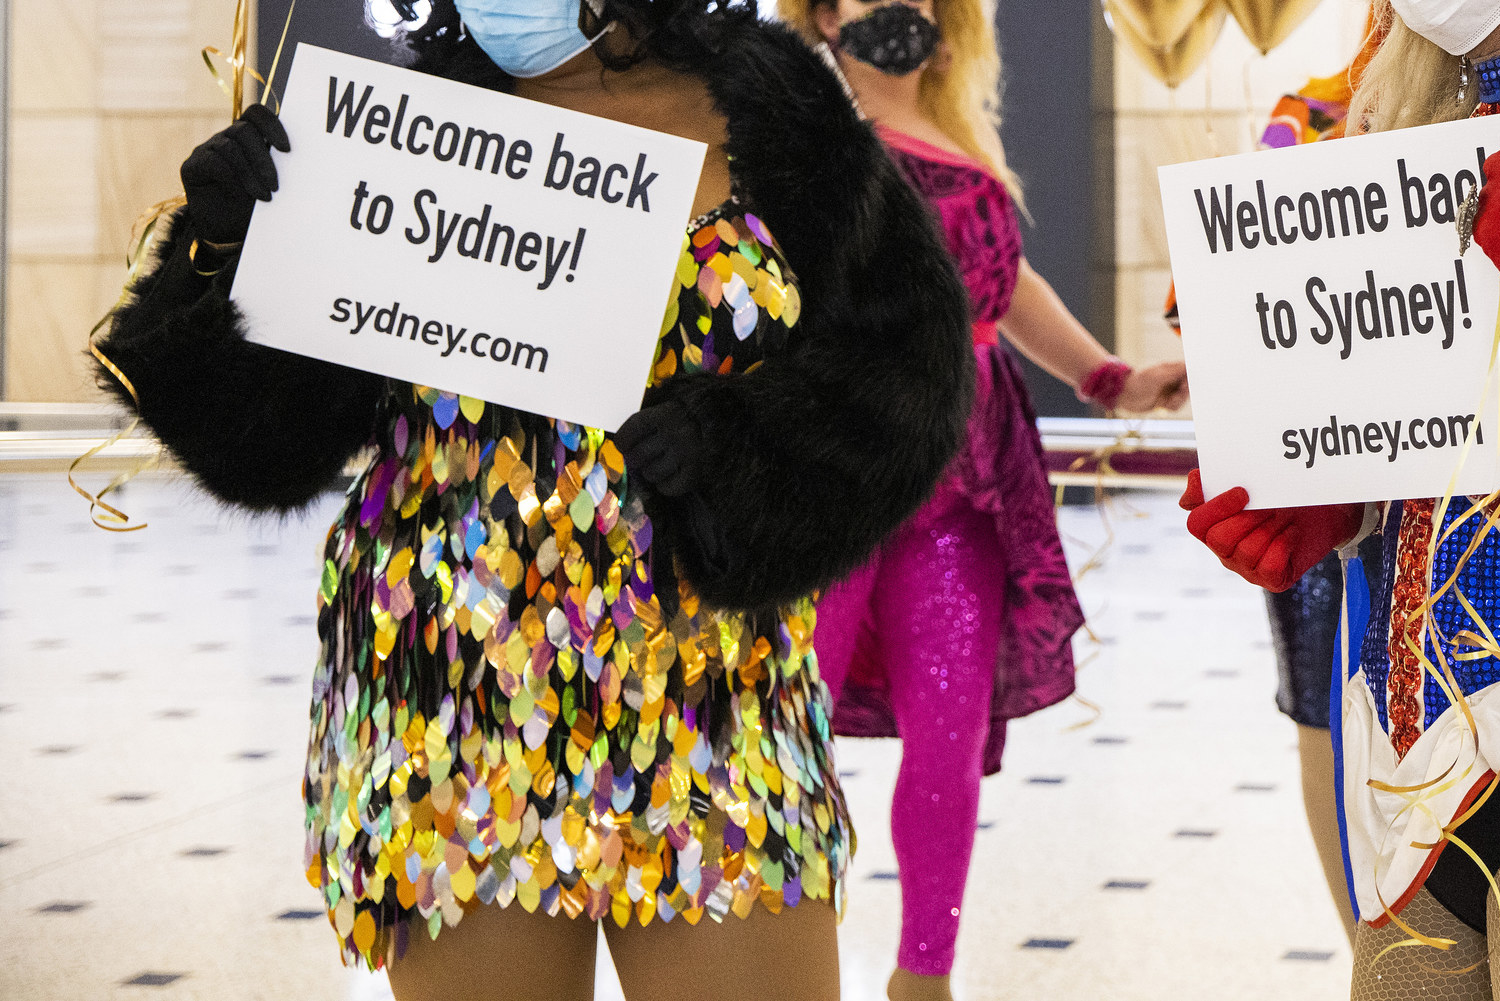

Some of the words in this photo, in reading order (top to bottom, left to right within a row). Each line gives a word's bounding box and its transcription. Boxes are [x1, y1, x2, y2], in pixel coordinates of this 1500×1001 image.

[326, 76, 532, 179] Welcome
[544, 133, 659, 212] back
[350, 180, 394, 234] to
[405, 188, 586, 290] Sydney!
[1194, 180, 1389, 253] Welcome
[329, 297, 549, 372] sydney.com
[1256, 292, 1298, 350] to
[1306, 259, 1472, 360] Sydney!
[1281, 414, 1483, 468] sydney.com
